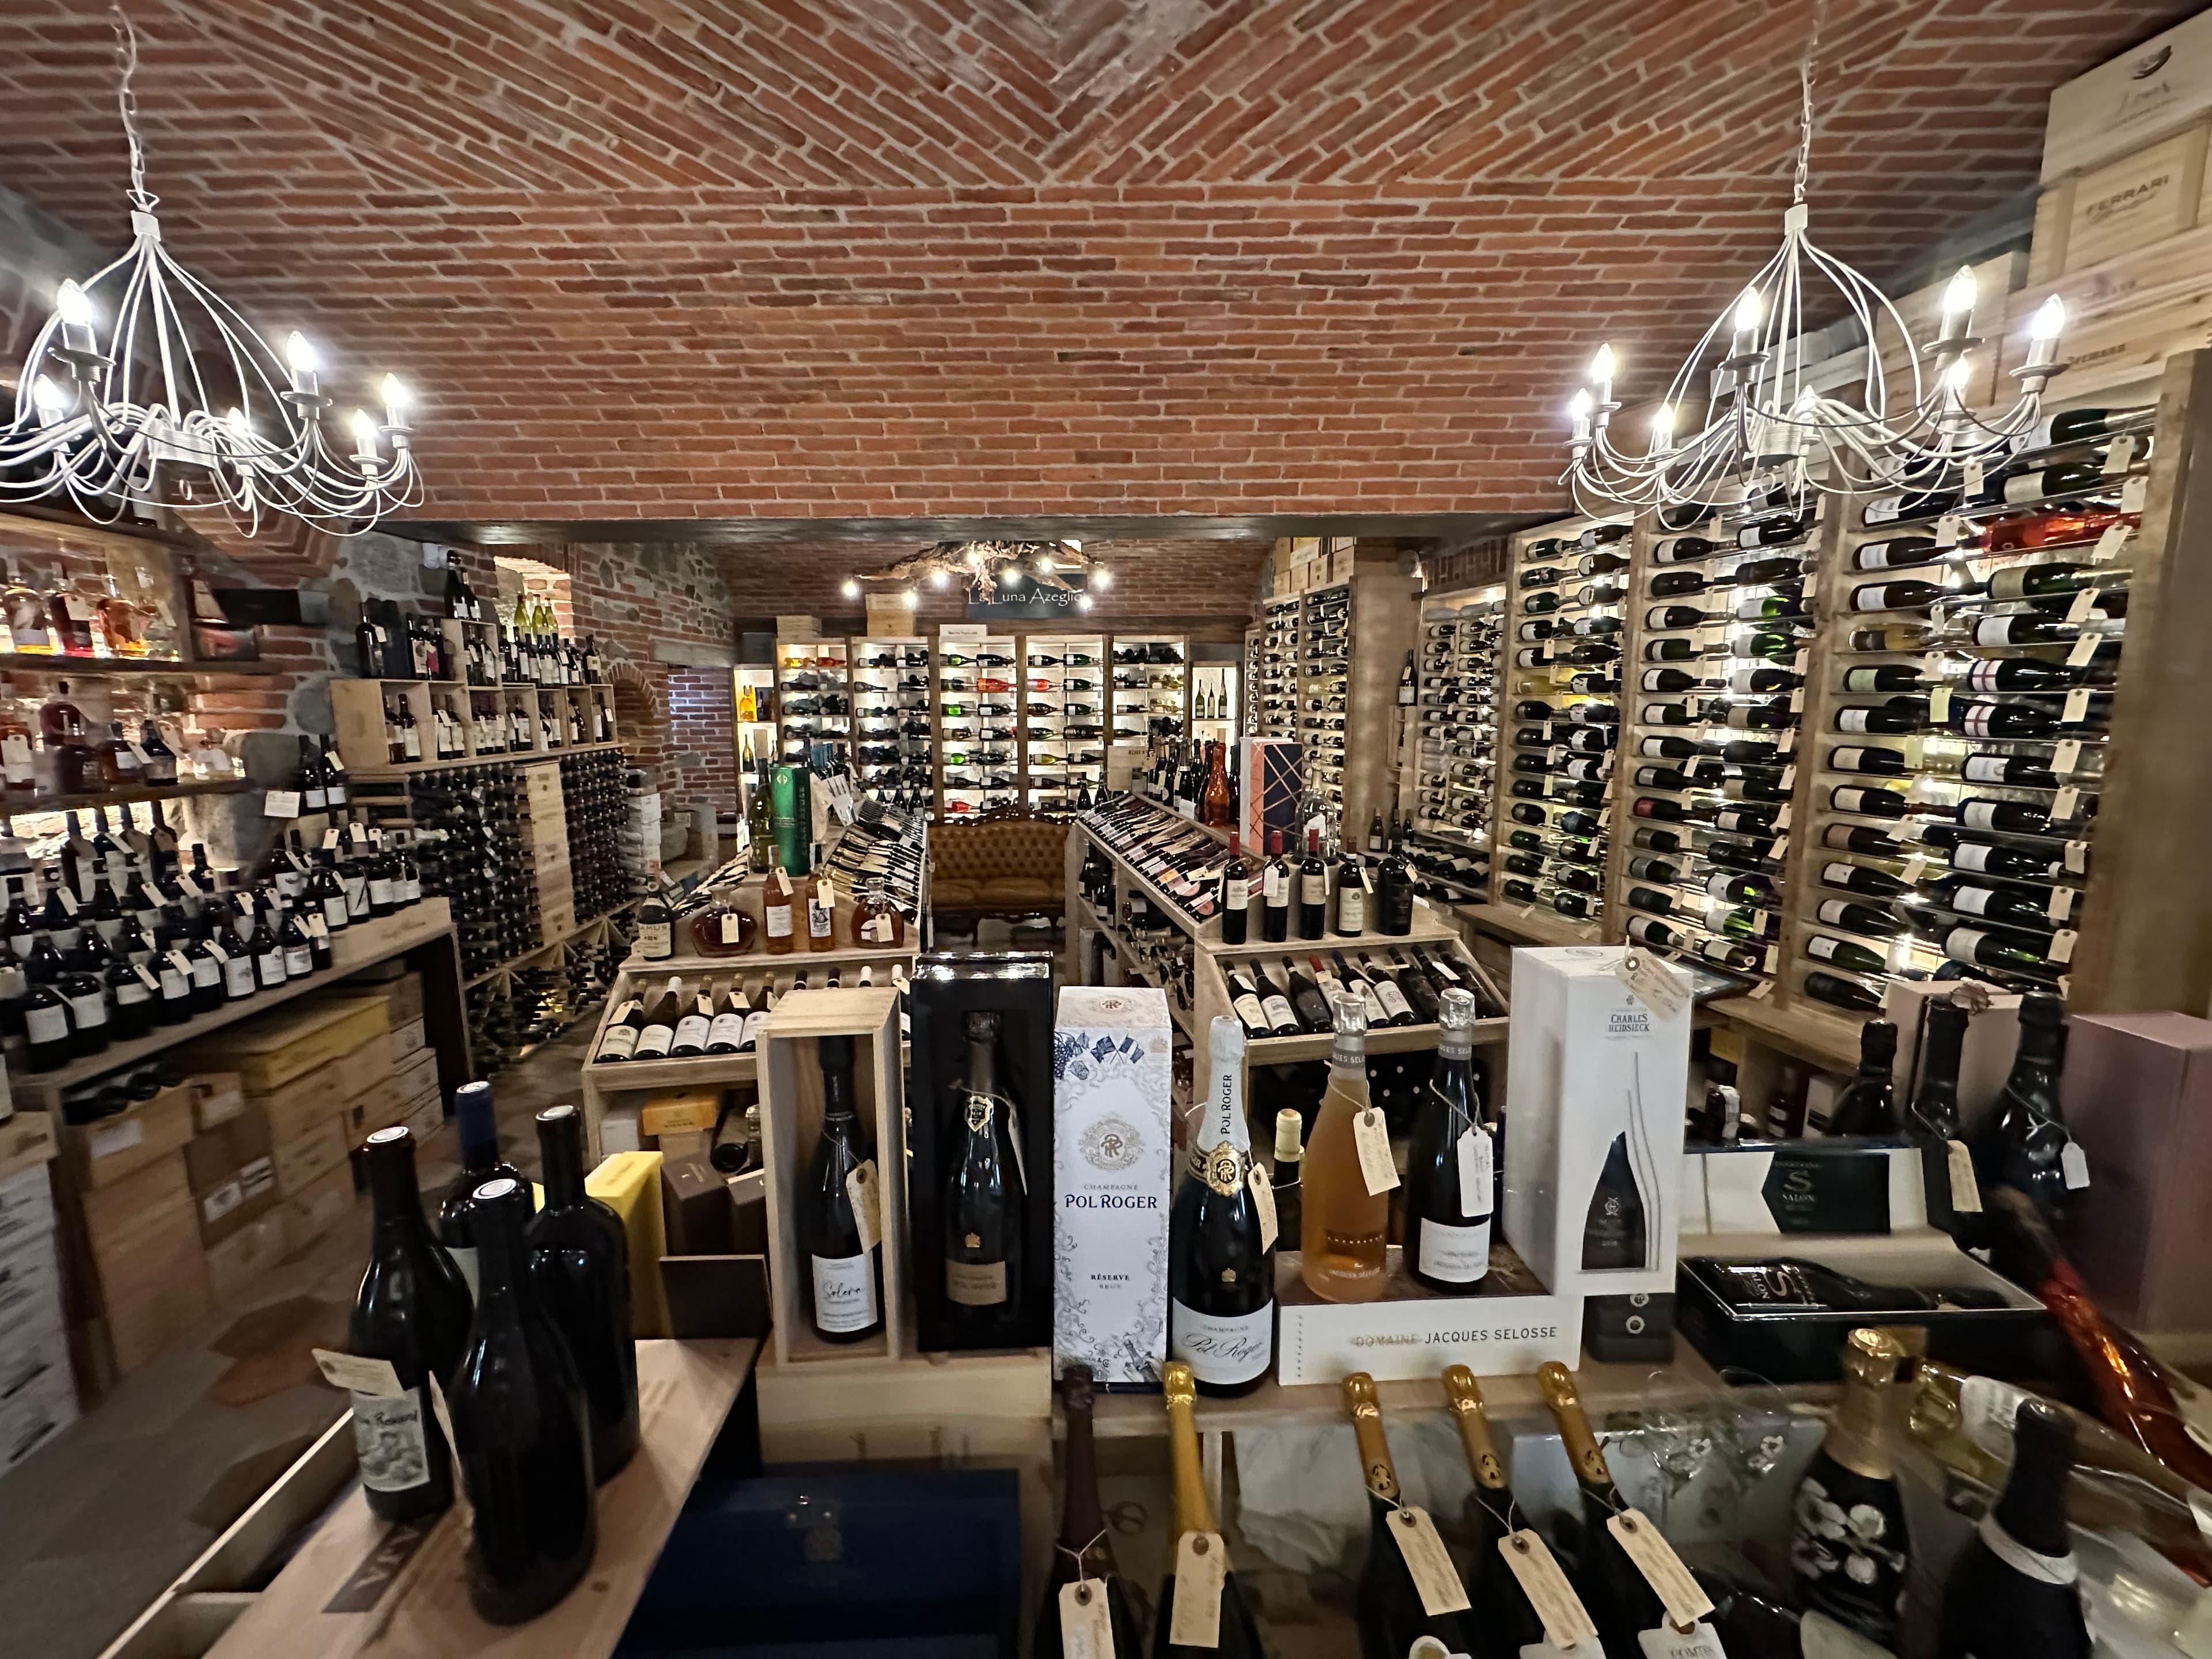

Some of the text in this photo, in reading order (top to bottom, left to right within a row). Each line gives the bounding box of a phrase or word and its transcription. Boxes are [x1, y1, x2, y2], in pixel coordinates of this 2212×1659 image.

[2086, 175, 2169, 215] FERRARI
[991, 588, 1026, 605] Luna
[1029, 587, 1083, 607] Azeglio
[1611, 1013, 1648, 1024] CHARLES
[1608, 1023, 1650, 1033] HEIDSIECK
[1221, 1074, 1232, 1135] POL ROGER
[1064, 1194, 1157, 1209] POL ROGER
[1782, 1194, 1814, 1202] SALON
[1090, 1272, 1130, 1281] RÉSERVE
[823, 1281, 861, 1300] Solera
[1425, 1330, 1488, 1344] JACQUES
[1494, 1327, 1557, 1340] SELOSSE
[1181, 1332, 1264, 1363] Pol Roger
